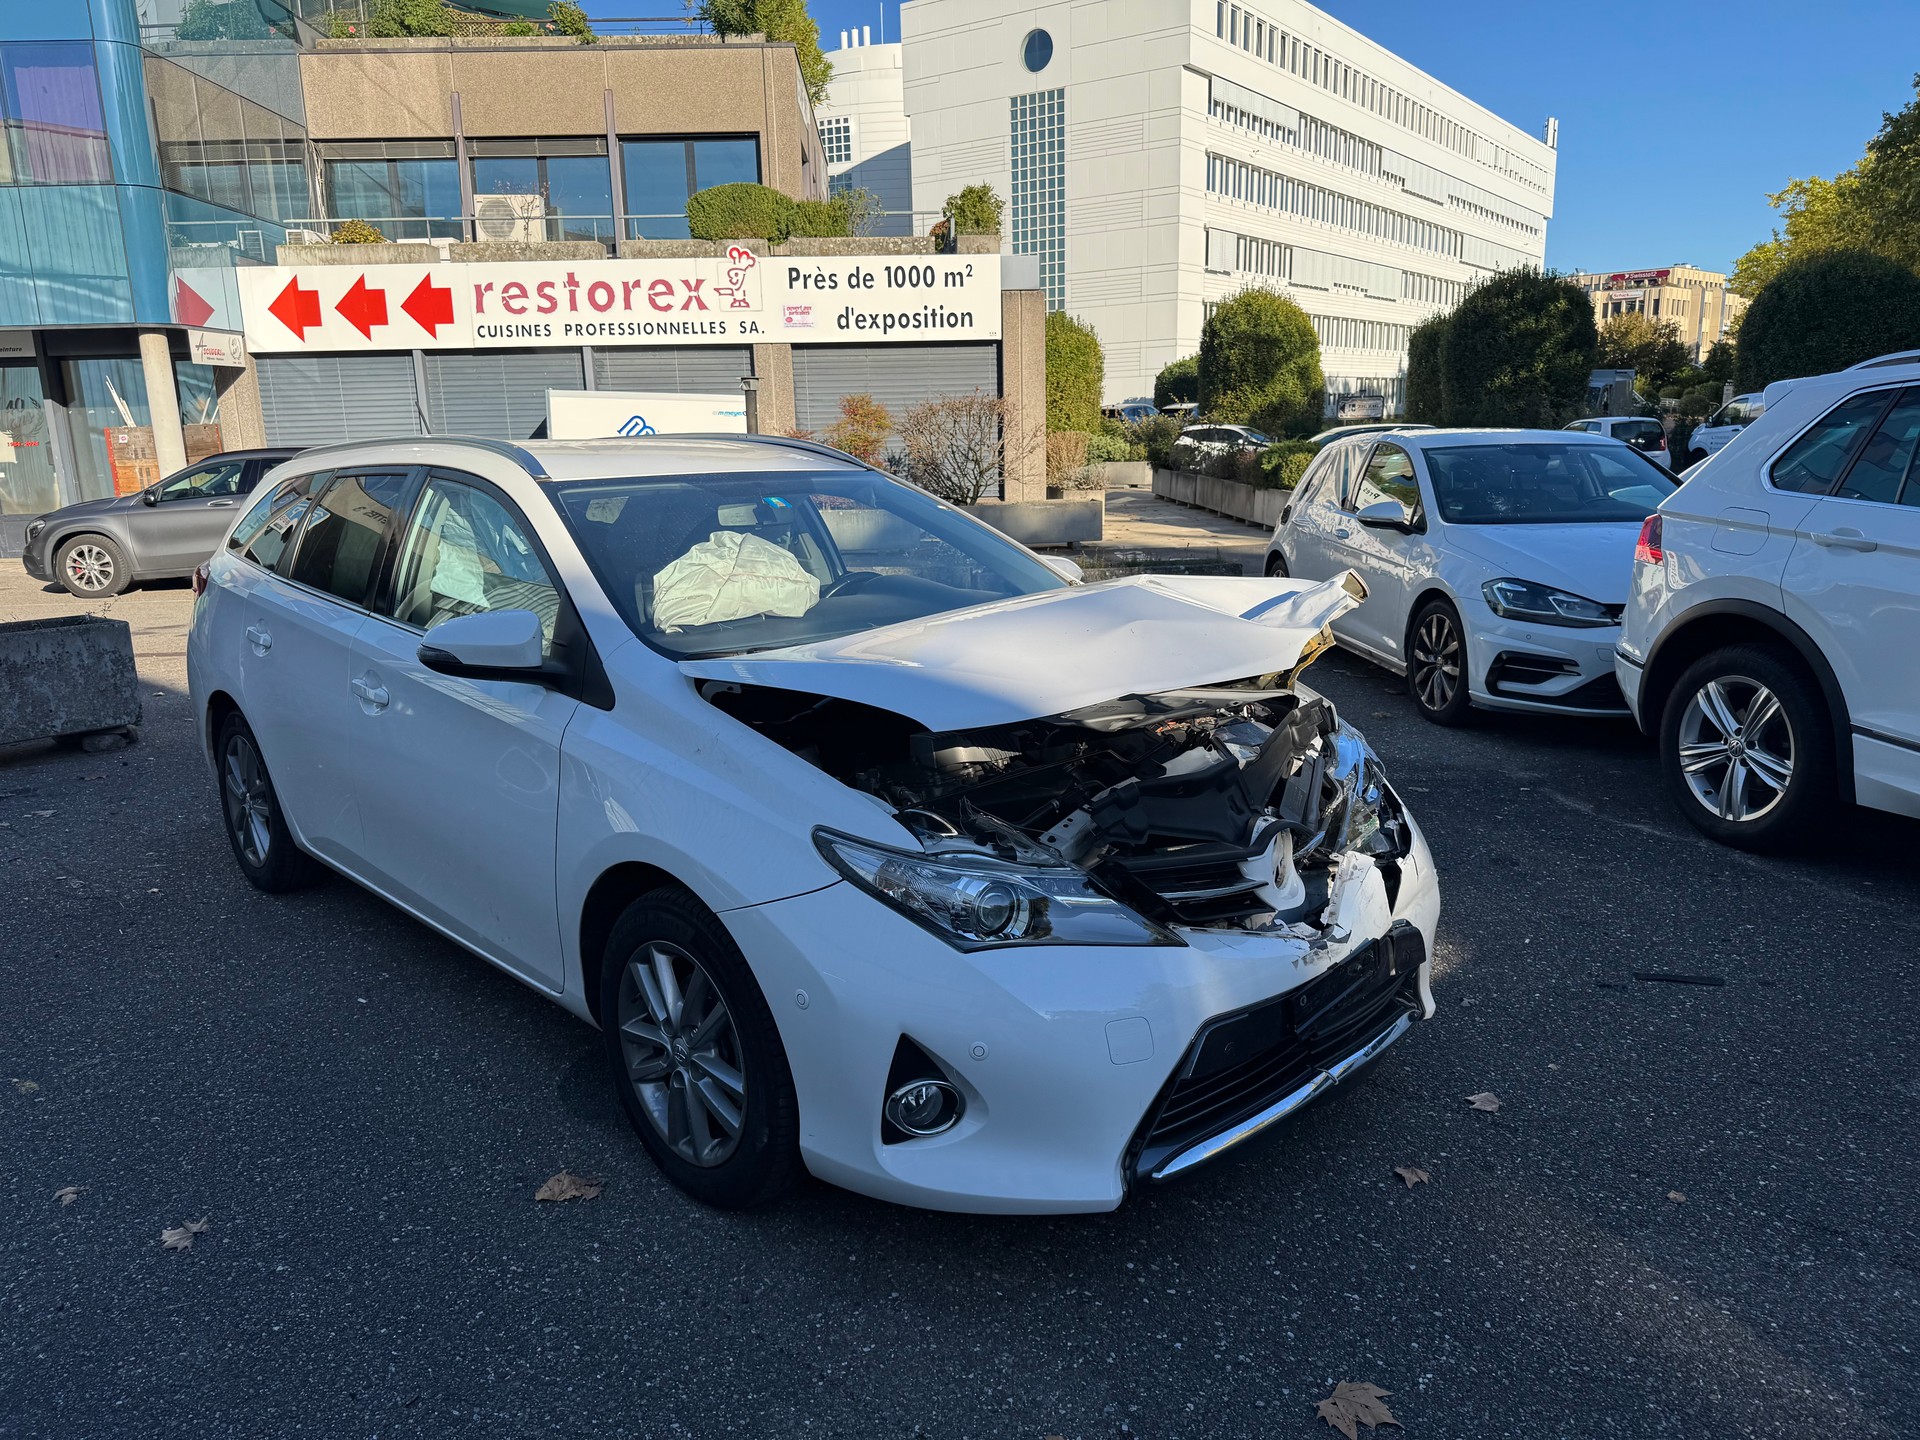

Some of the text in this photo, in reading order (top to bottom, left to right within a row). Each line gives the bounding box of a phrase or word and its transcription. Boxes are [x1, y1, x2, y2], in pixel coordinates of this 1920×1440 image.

[788, 266, 838, 290] Près
[847, 266, 875, 290] de
[884, 265, 936, 288] 1000
[473, 272, 710, 314] restorex
[477, 320, 765, 338] CUISINES PROFESSIONNELLES SA.
[837, 305, 974, 335] d'exposition
